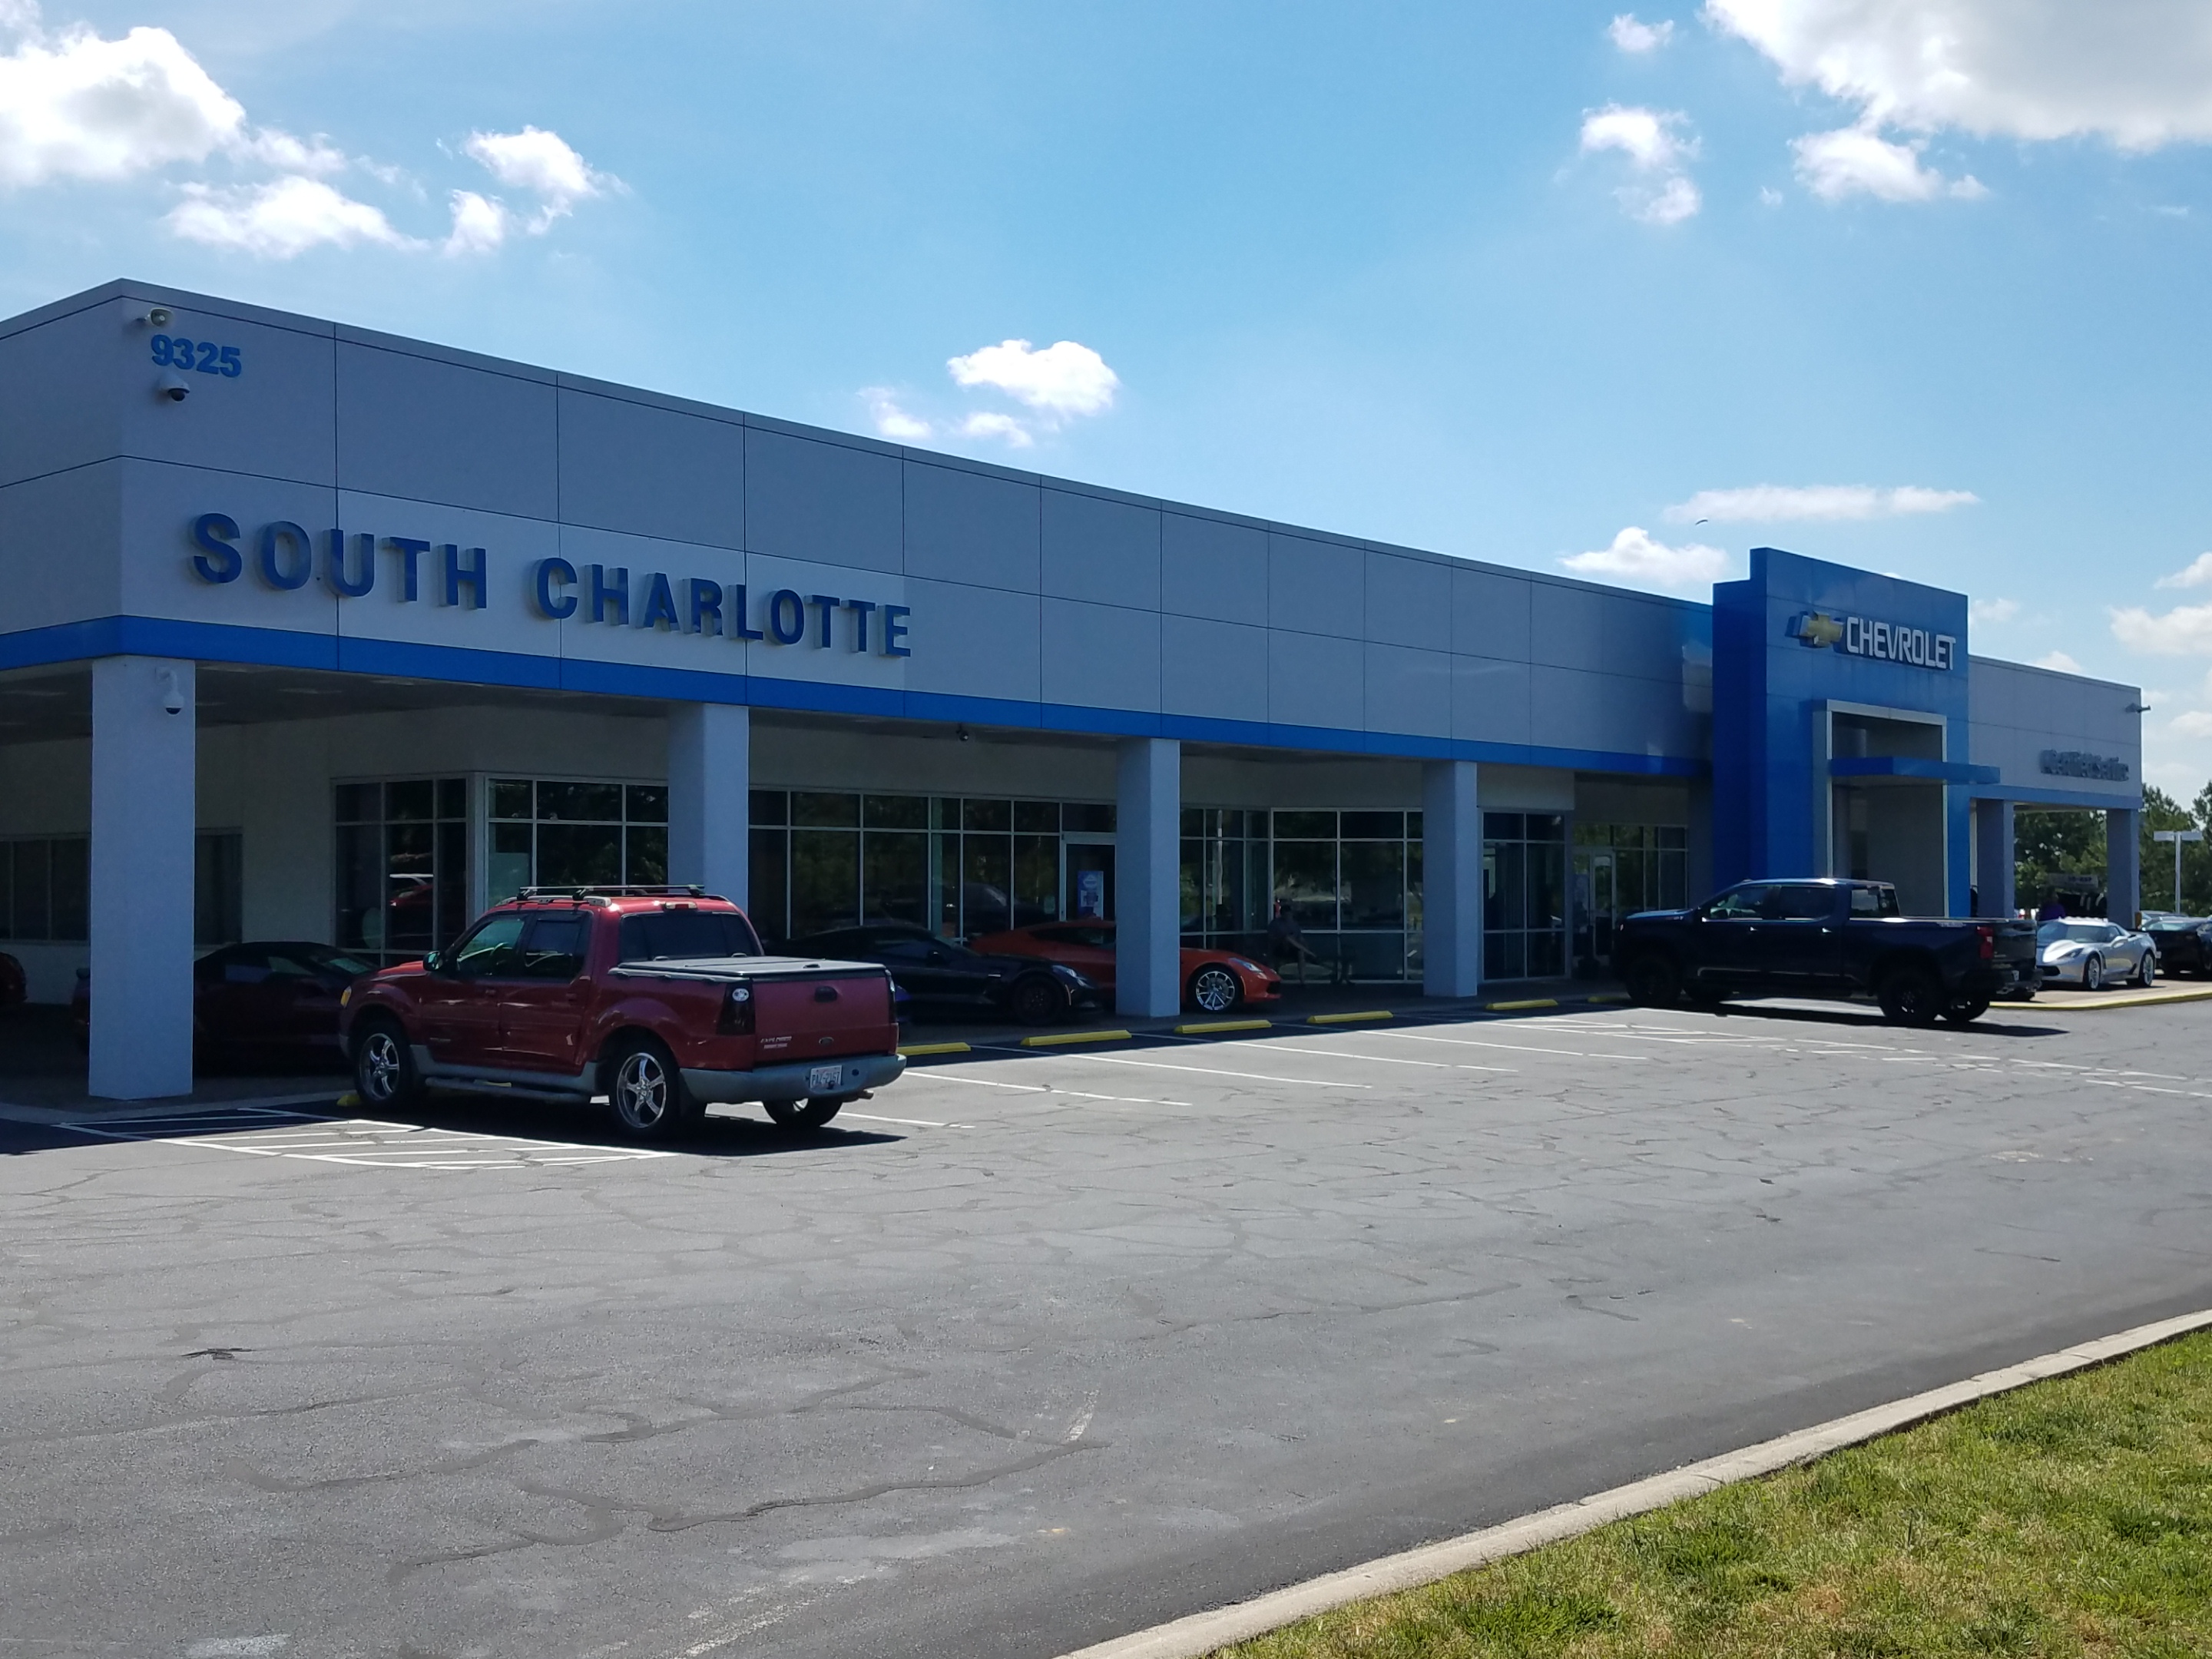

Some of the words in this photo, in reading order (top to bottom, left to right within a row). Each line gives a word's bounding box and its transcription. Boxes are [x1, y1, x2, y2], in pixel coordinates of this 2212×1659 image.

[151, 333, 242, 378] 9325
[191, 512, 487, 610] SOUTH
[534, 557, 912, 657] CHARLOTTE
[1846, 616, 1957, 671] CHEVROLET
